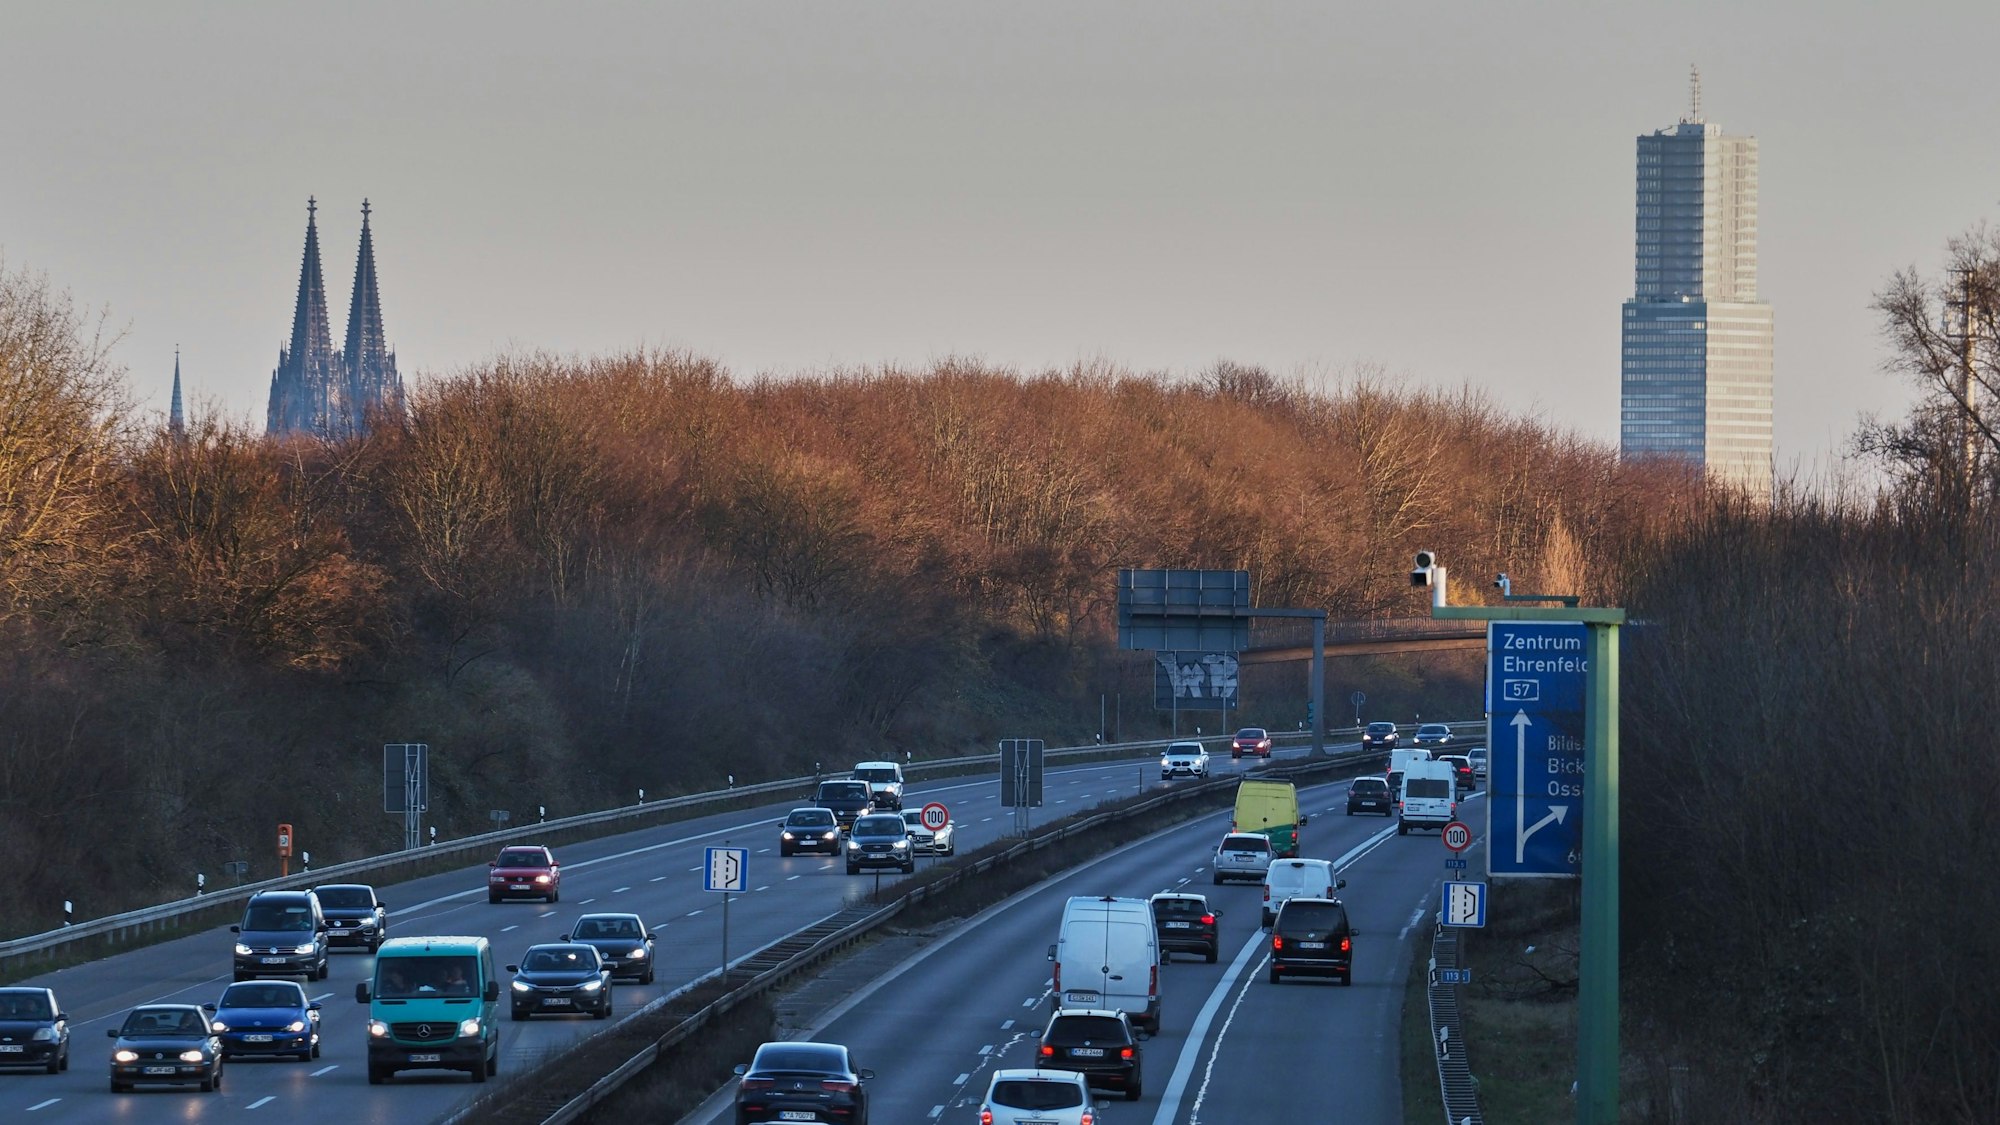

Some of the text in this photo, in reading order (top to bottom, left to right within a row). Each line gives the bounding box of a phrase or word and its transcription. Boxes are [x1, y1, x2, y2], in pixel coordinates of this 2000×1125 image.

[1503, 633, 1581, 650] Zentrum
[1513, 683, 1530, 697] 57
[1548, 735, 1585, 751] Bilde
[1548, 780, 1584, 797] Oss
[926, 810, 944, 824] 100
[1448, 830, 1466, 844] 100
[1568, 849, 1582, 863] 6
